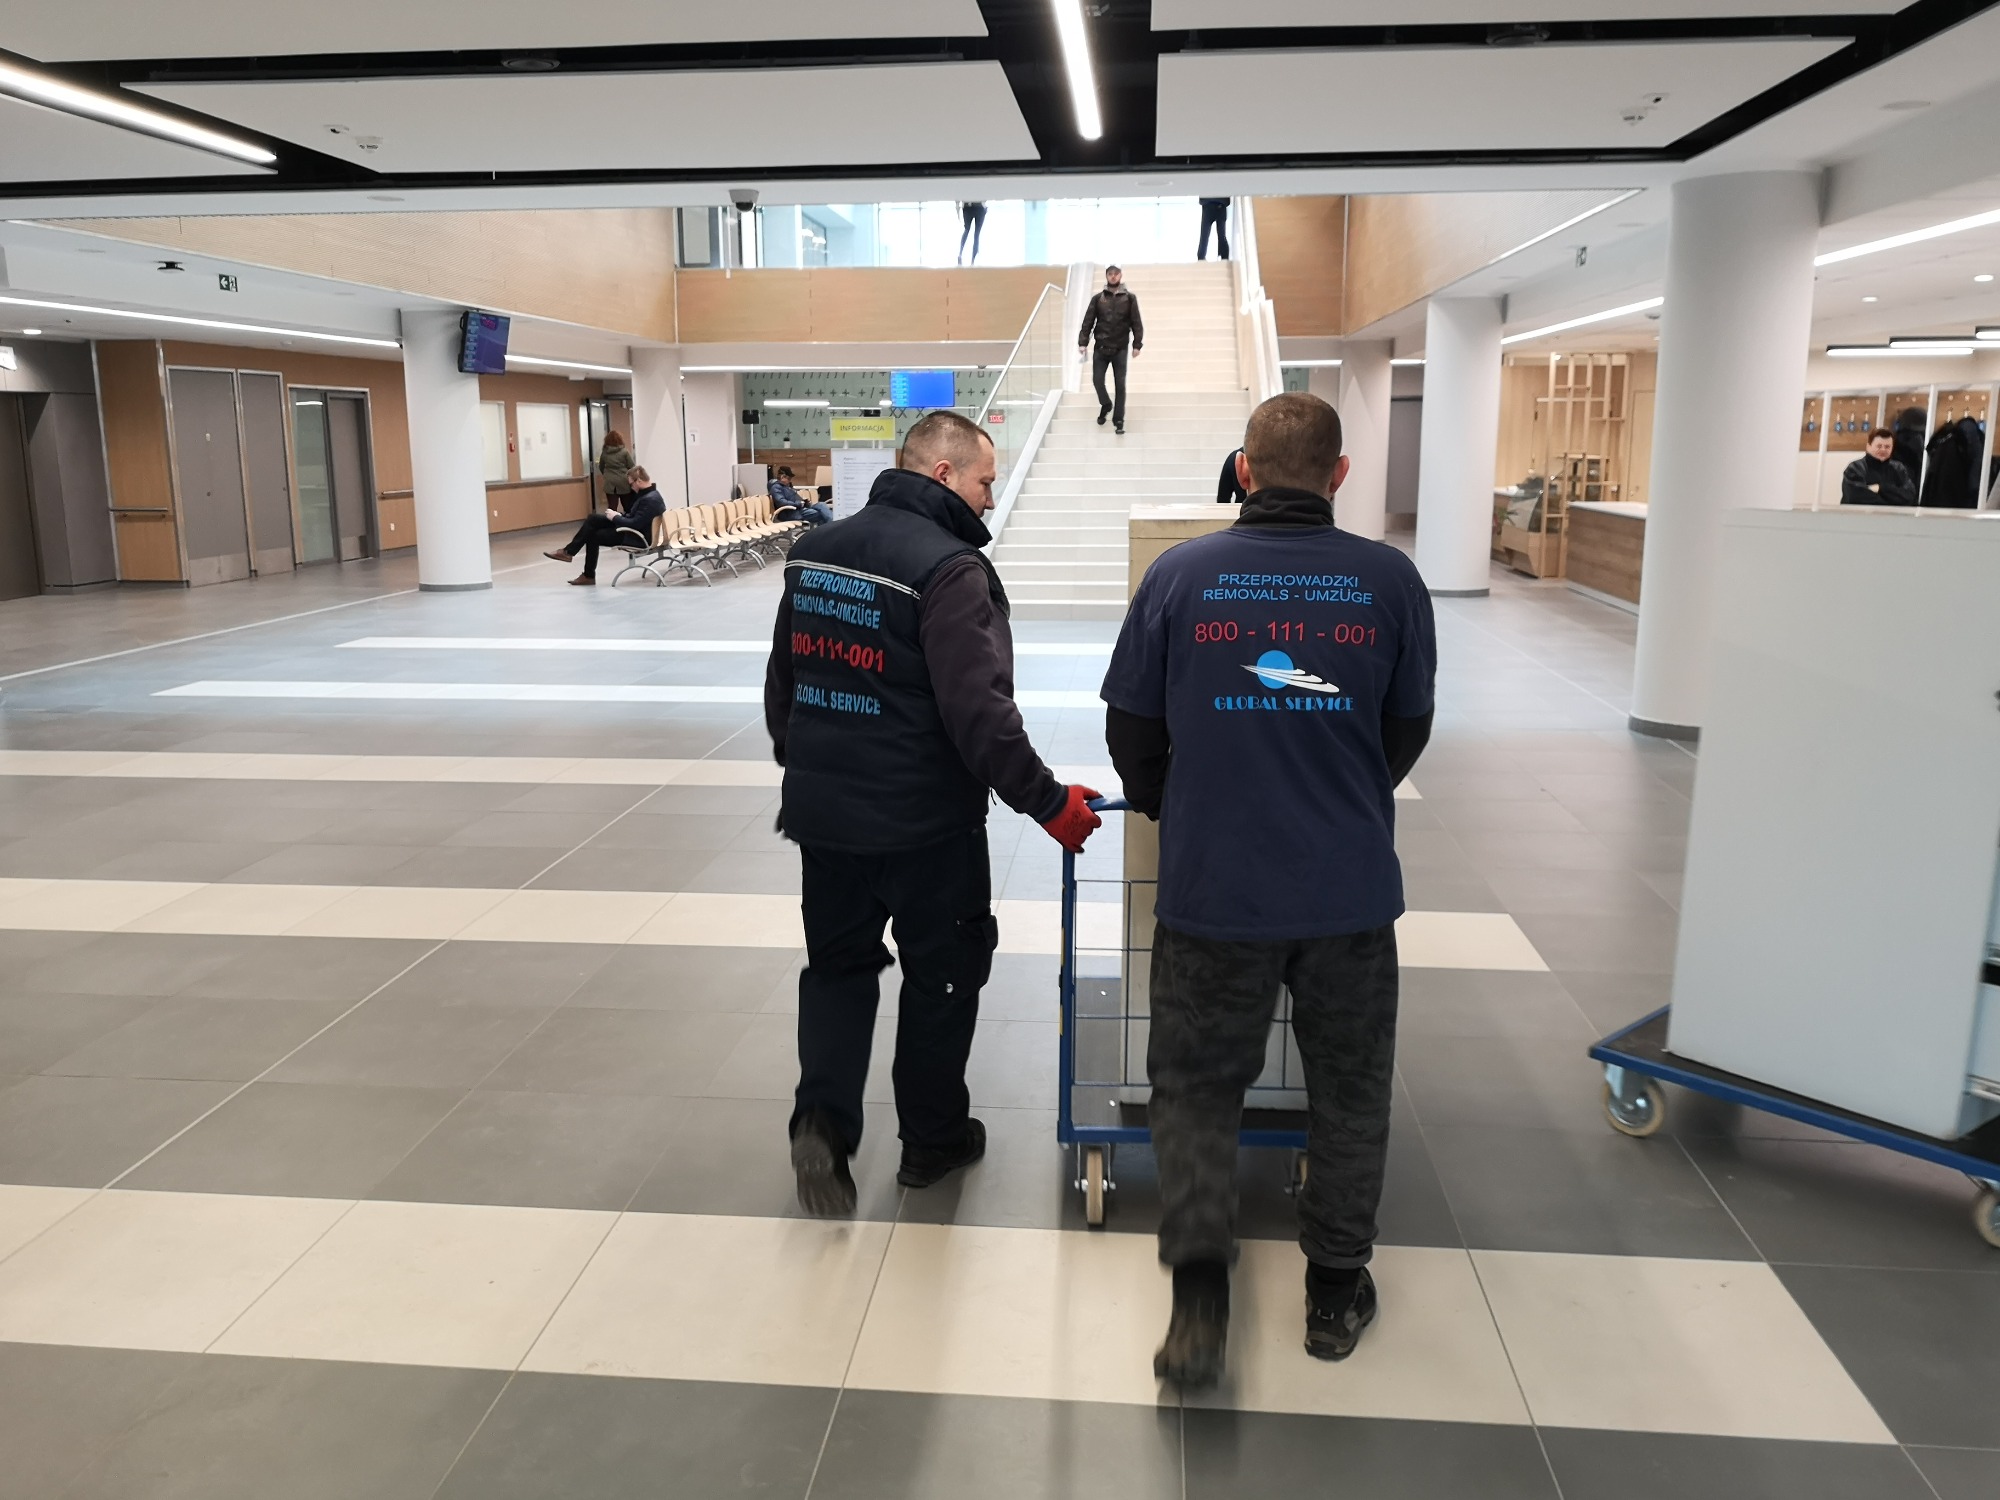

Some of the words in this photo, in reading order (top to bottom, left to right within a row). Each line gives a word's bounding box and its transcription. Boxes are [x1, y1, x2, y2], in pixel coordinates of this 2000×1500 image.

[799, 569, 876, 601] PRZEPROWADZKI
[1218, 573, 1358, 588] PRZEPROWADZKI
[1203, 588, 1289, 601] REMOVALS
[1304, 588, 1372, 605] UMZÜGE
[1194, 621, 1238, 643] 800
[1267, 620, 1305, 641] 111
[1334, 623, 1377, 647] 001
[792, 631, 885, 672] 800-111-001
[830, 690, 881, 715] SERVICE
[1214, 695, 1281, 711] GLOBAL
[1285, 696, 1354, 711] SERVICE
